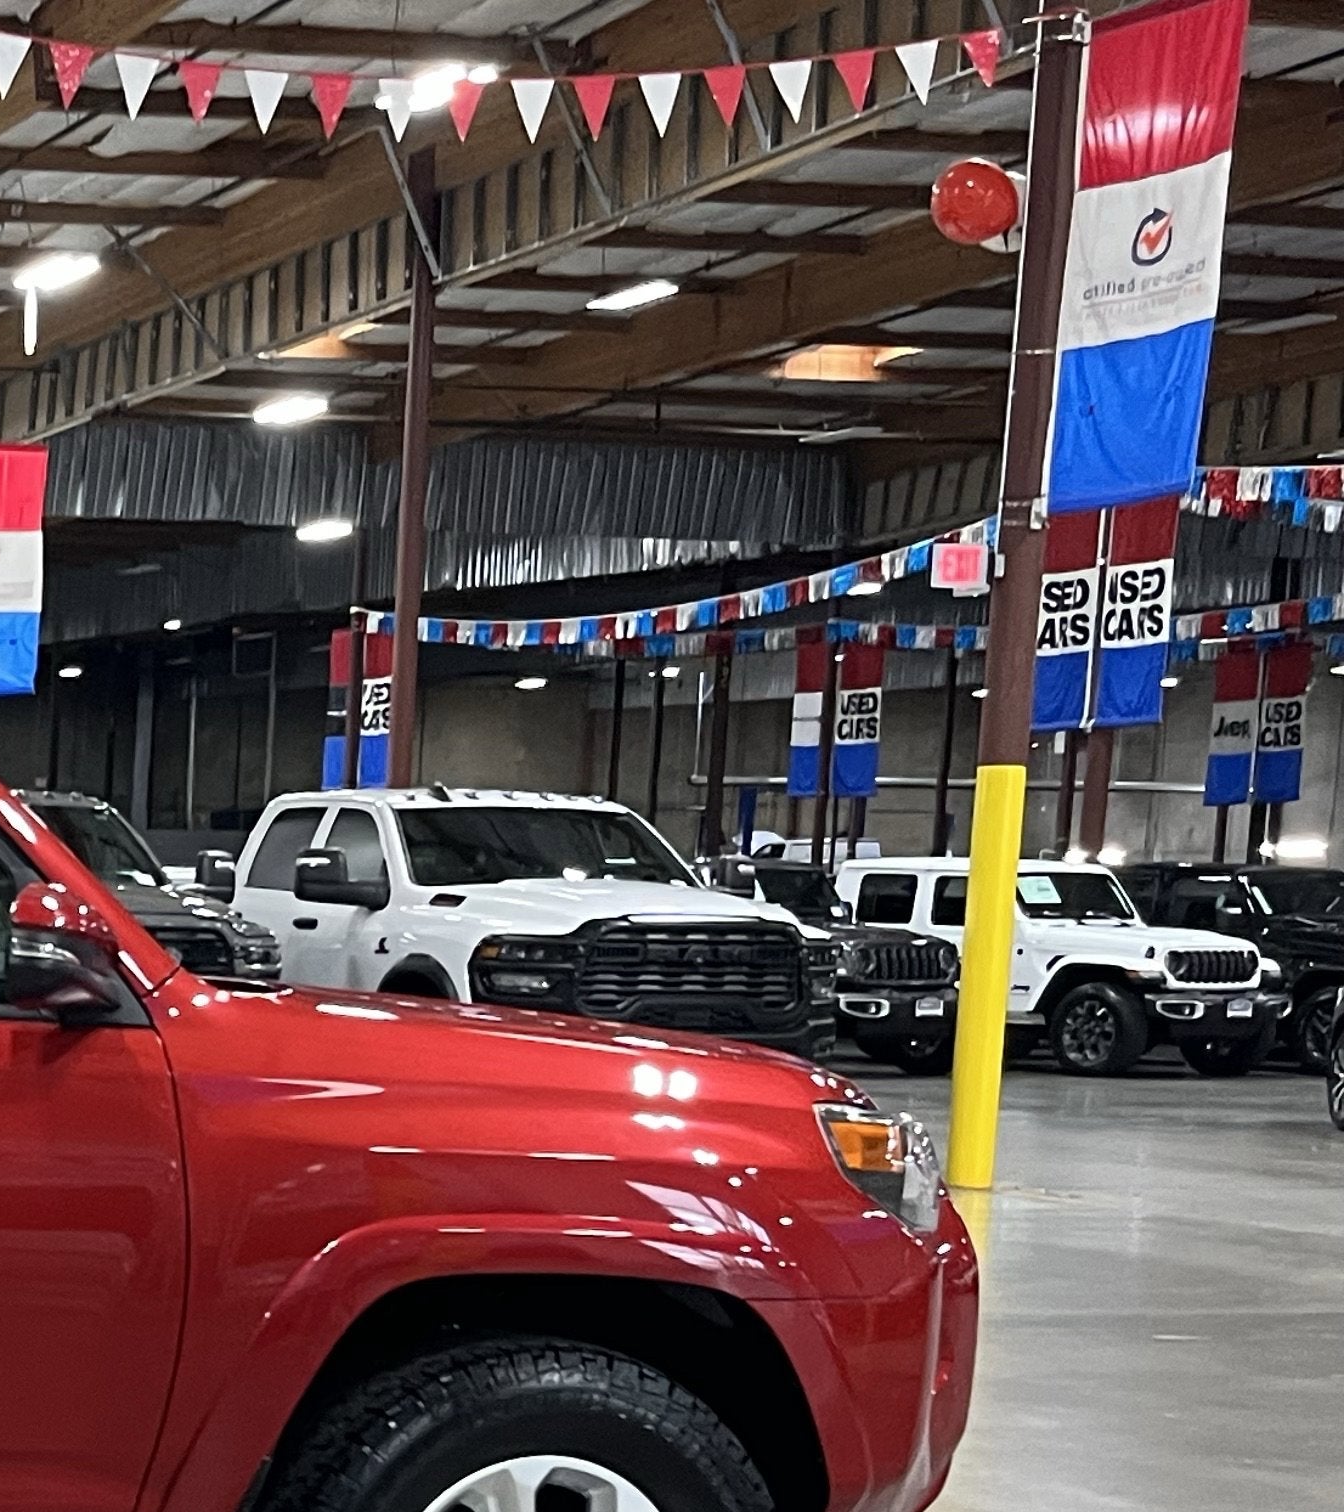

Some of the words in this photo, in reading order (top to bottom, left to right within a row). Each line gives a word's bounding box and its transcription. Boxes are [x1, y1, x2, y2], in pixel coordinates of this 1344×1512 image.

[1042, 578, 1090, 614] SED
[1037, 613, 1090, 649] ARS
[1265, 701, 1302, 724] USD
